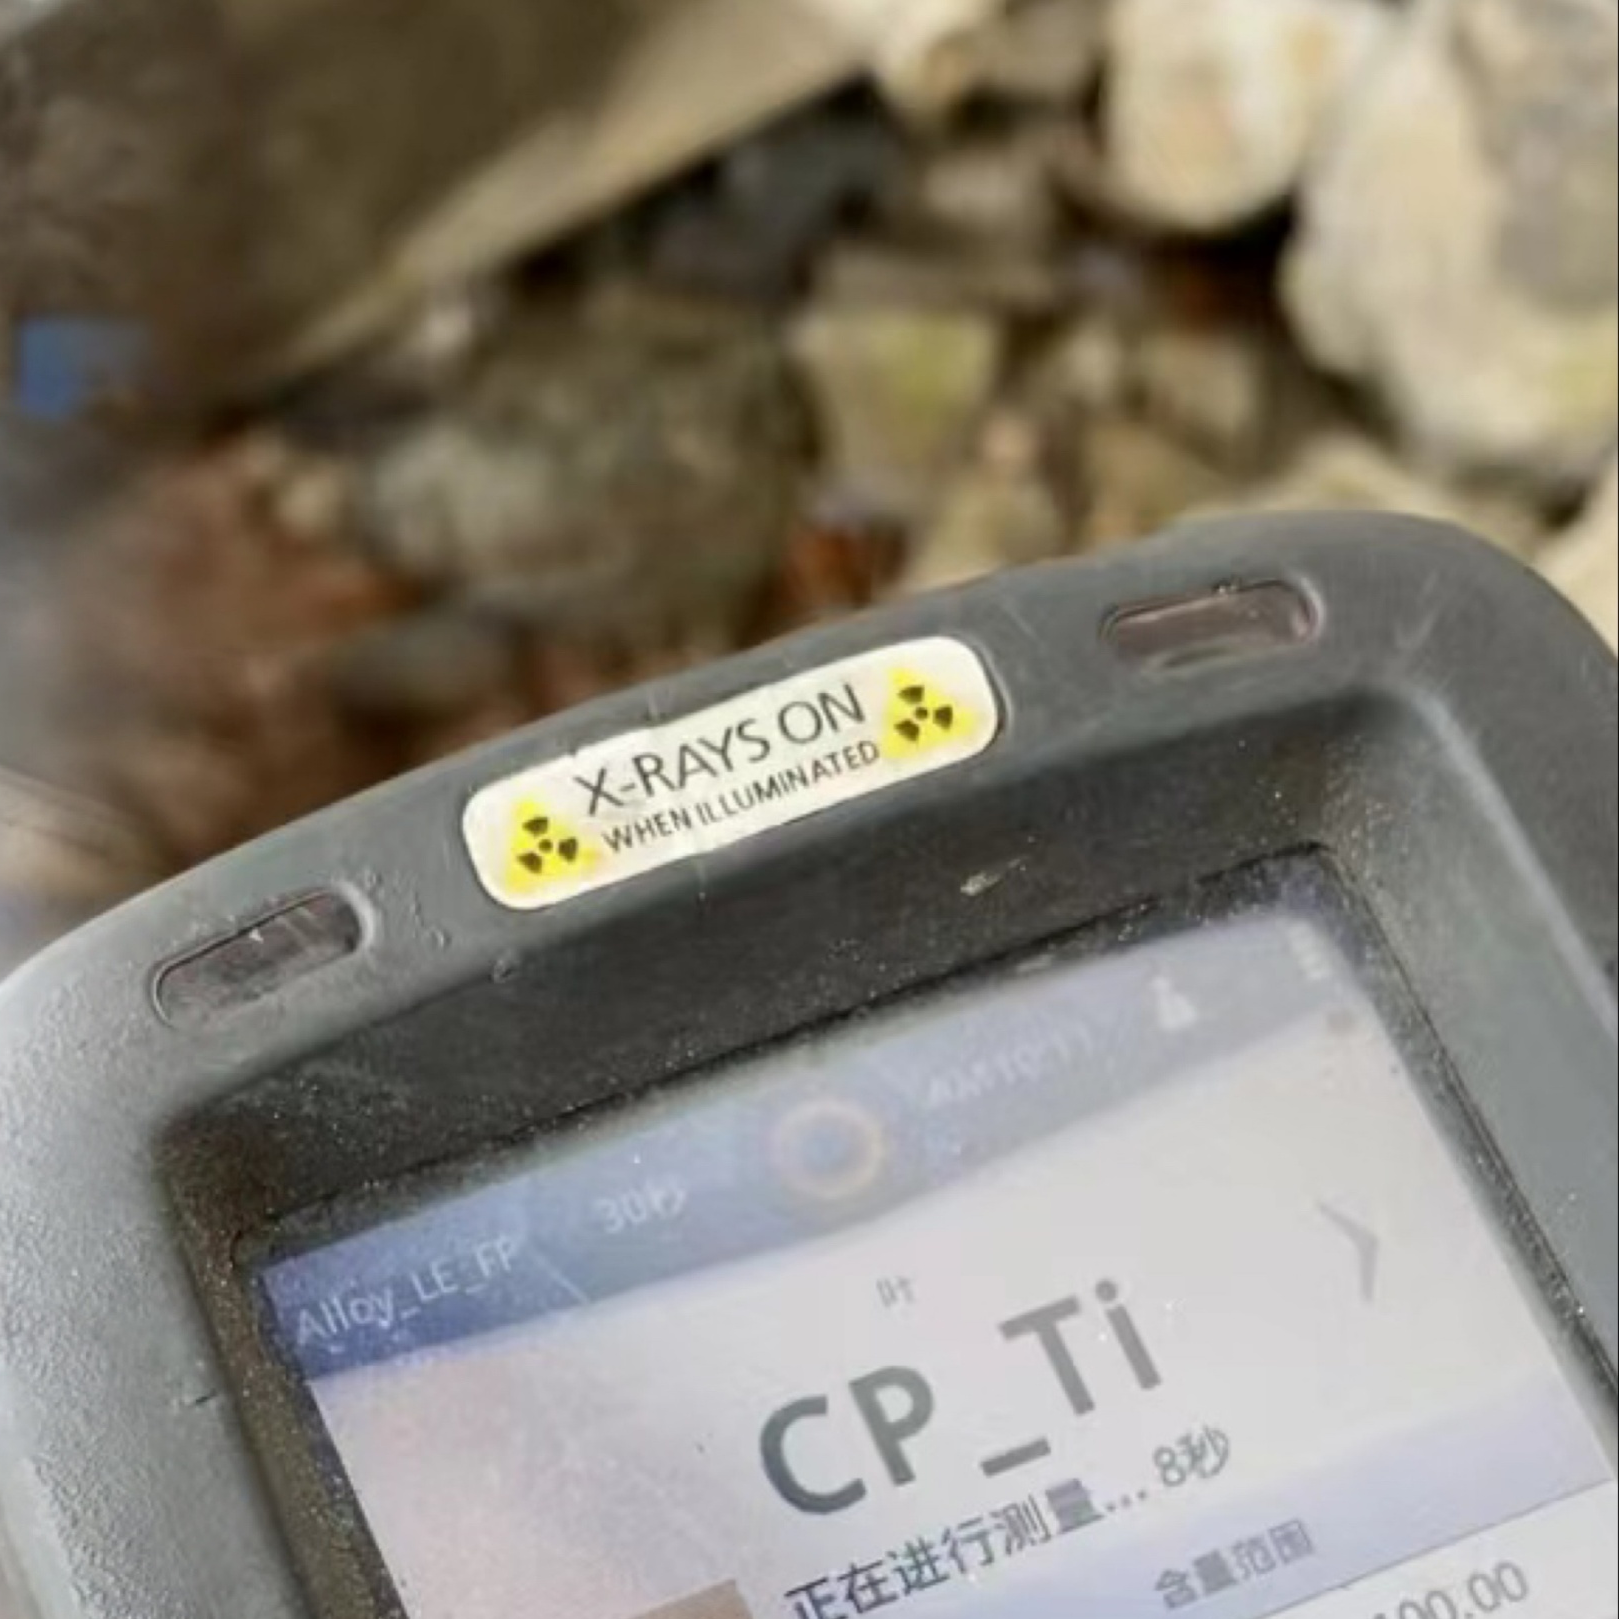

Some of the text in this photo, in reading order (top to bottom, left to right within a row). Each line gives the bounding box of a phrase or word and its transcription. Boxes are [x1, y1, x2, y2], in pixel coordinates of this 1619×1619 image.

[575, 682, 867, 817] X-RAYS ON
[603, 739, 880, 856] WHEN ILLUMINATED
[296, 1232, 522, 1344] Alloy_LE_FP
[759, 1279, 1161, 1514] CP_Ti
[1152, 1425, 1229, 1487] 8秒
